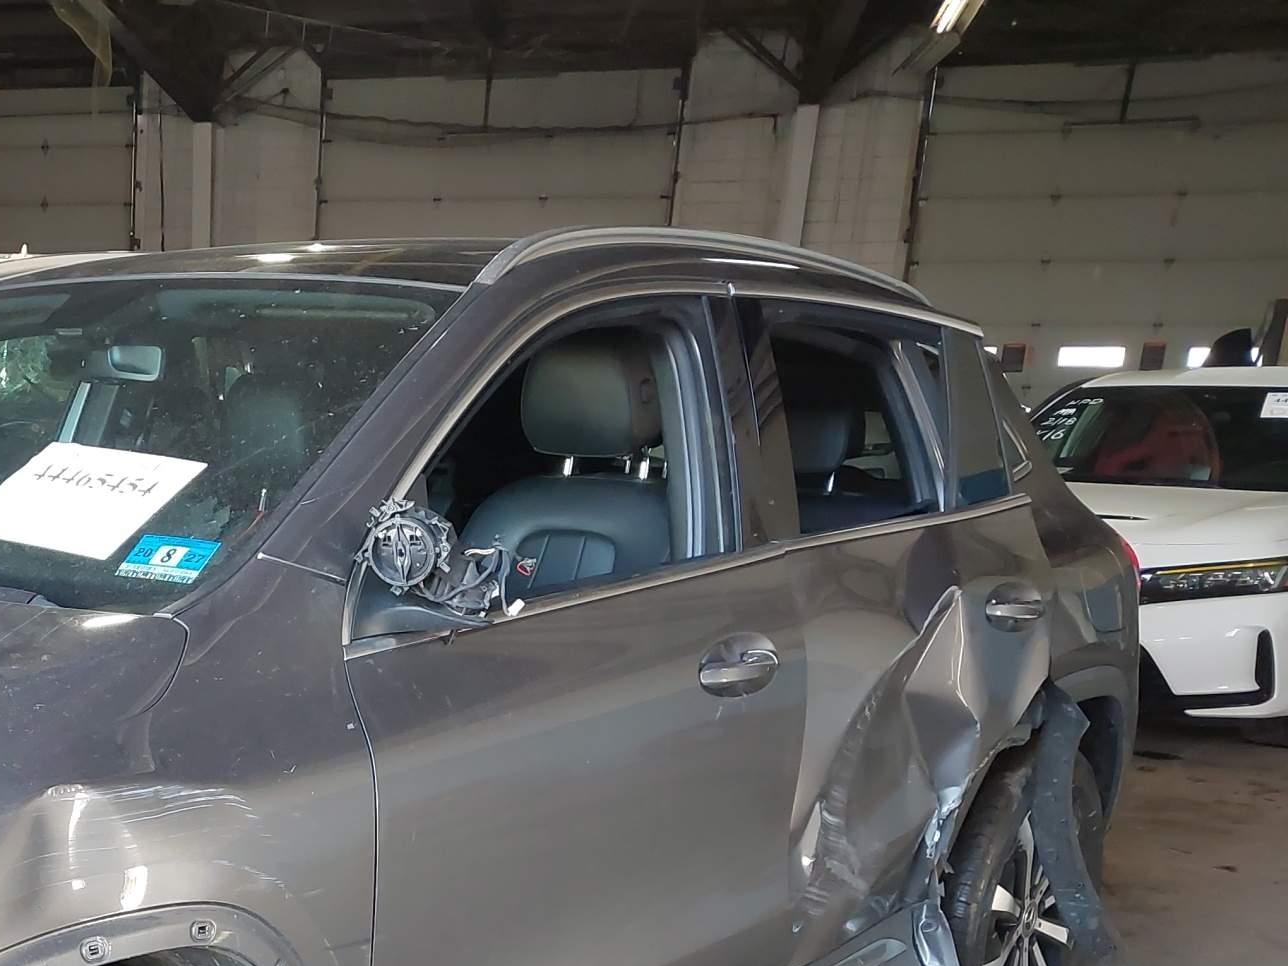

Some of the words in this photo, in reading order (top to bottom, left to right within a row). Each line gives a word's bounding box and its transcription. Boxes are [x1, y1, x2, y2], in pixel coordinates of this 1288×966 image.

[134, 547, 154, 558] 20
[160, 548, 178, 563] 8
[183, 553, 206, 564] 27
